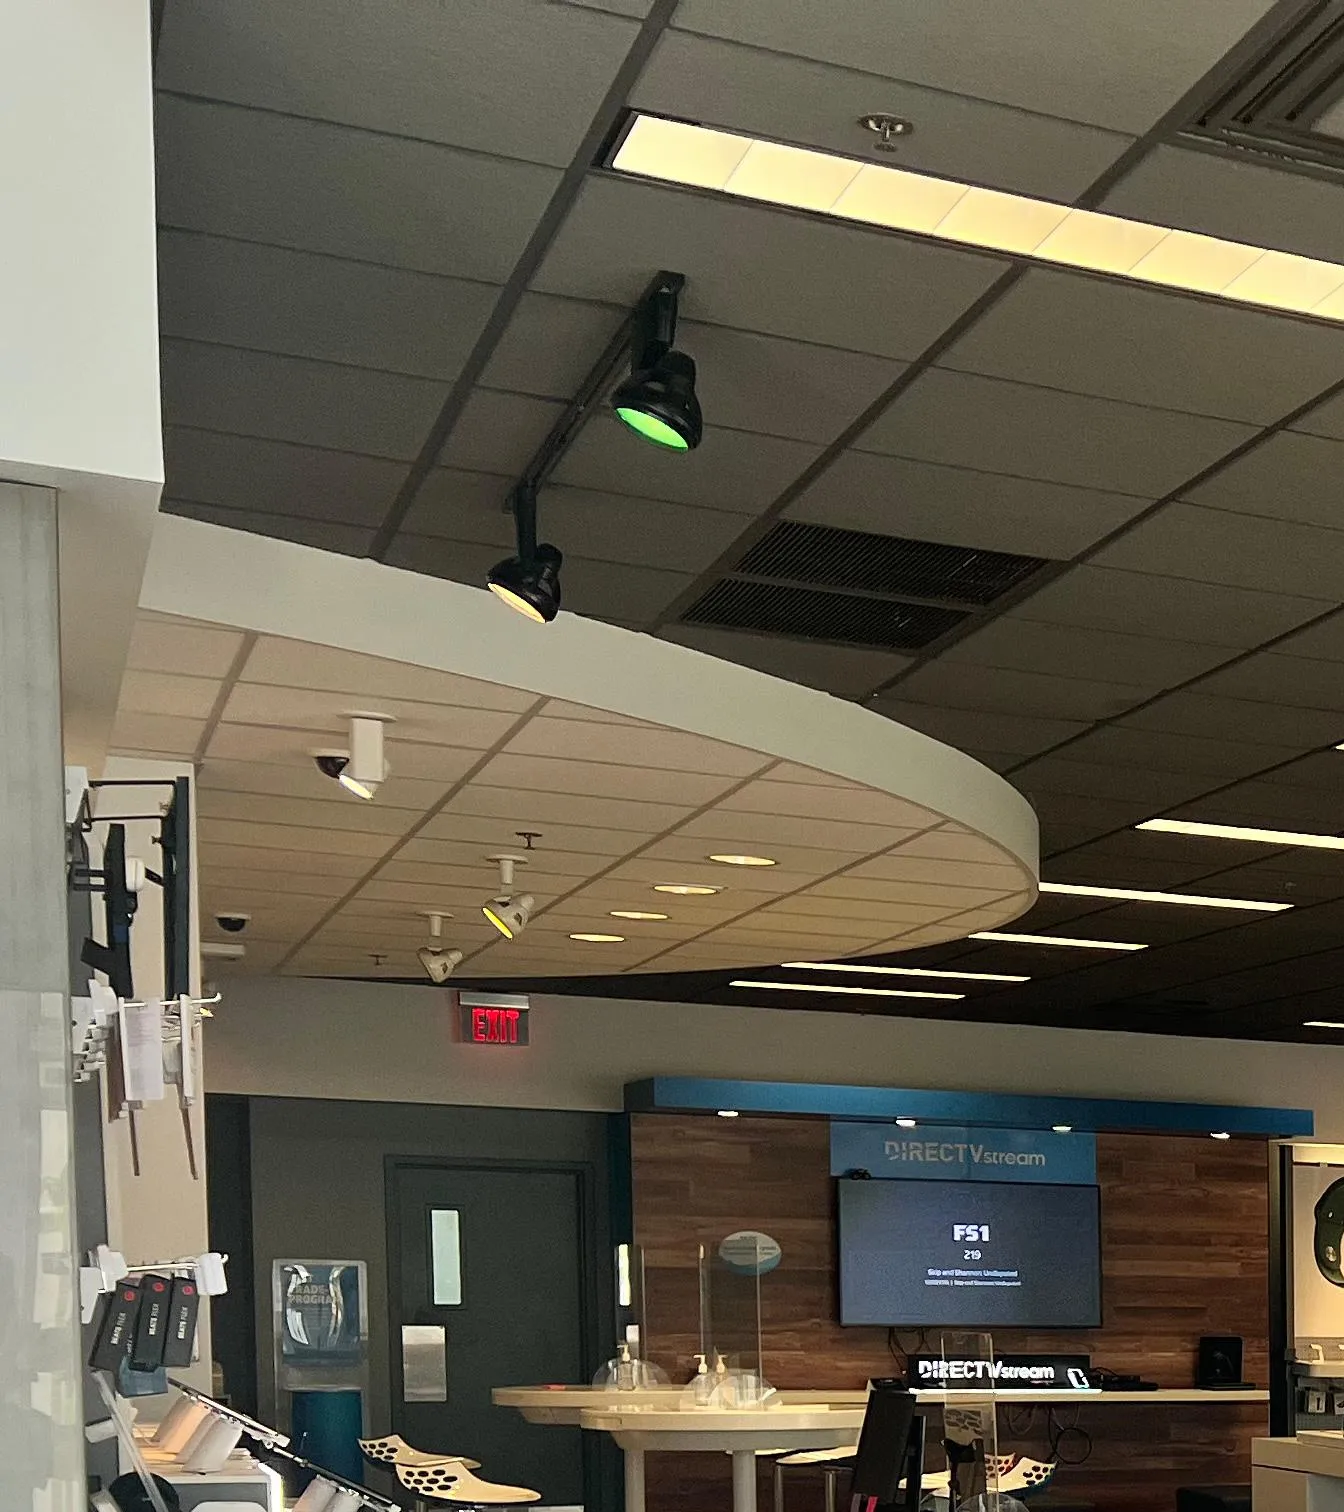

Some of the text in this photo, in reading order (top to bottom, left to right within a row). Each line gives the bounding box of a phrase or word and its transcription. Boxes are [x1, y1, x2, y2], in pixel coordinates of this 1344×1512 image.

[472, 1008, 520, 1043] EXIT
[953, 1225, 990, 1242] FS1
[963, 1249, 982, 1260] 219
[289, 1294, 333, 1304] PROGRA
